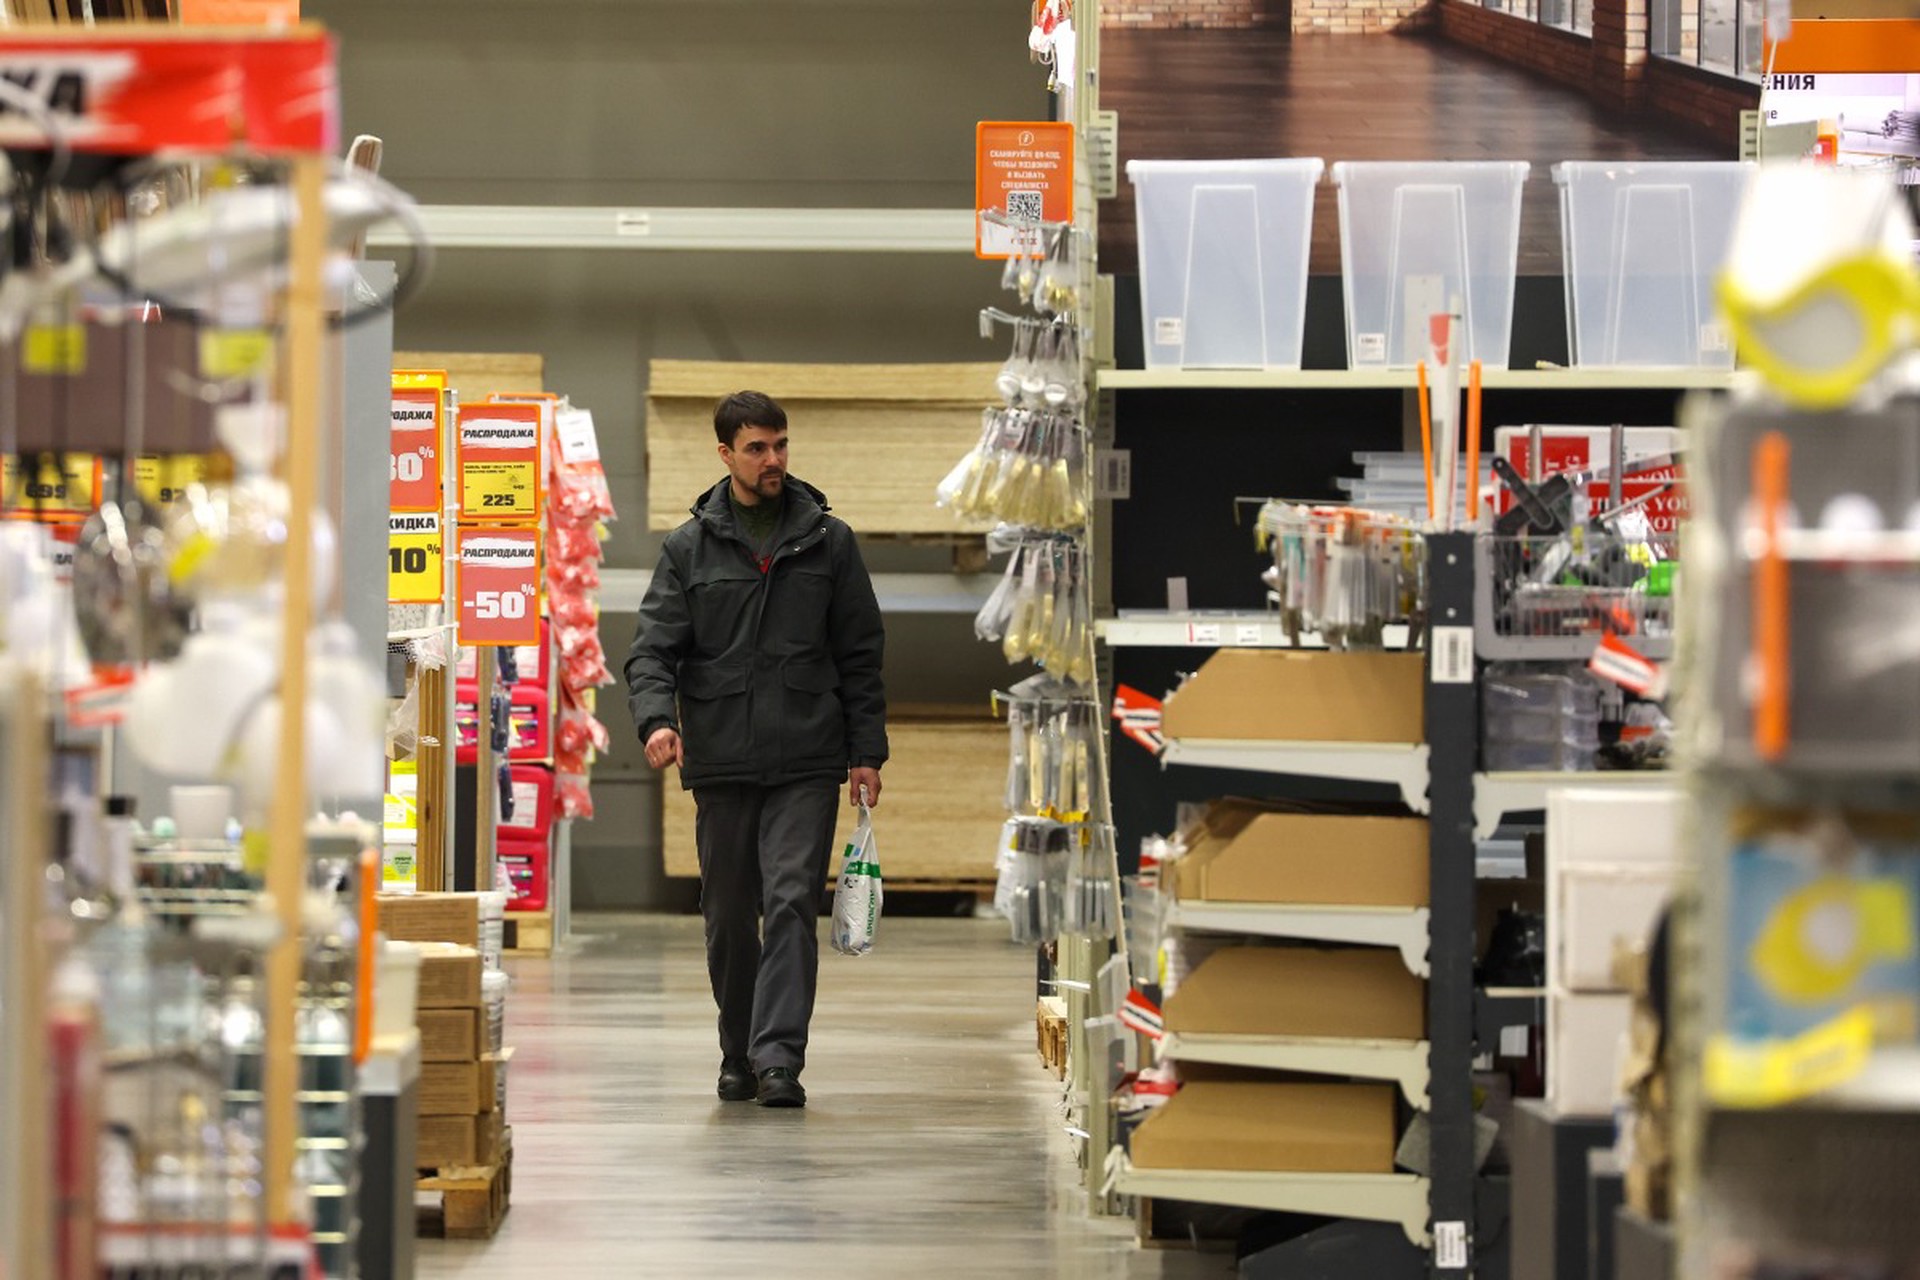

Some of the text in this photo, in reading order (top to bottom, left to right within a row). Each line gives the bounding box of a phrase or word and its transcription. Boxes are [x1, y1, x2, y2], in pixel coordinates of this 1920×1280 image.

[463, 429, 534, 439] РАСПРОДАЖА
[483, 494, 515, 506] 225
[463, 548, 535, 558] РАСПРОДАЖА
